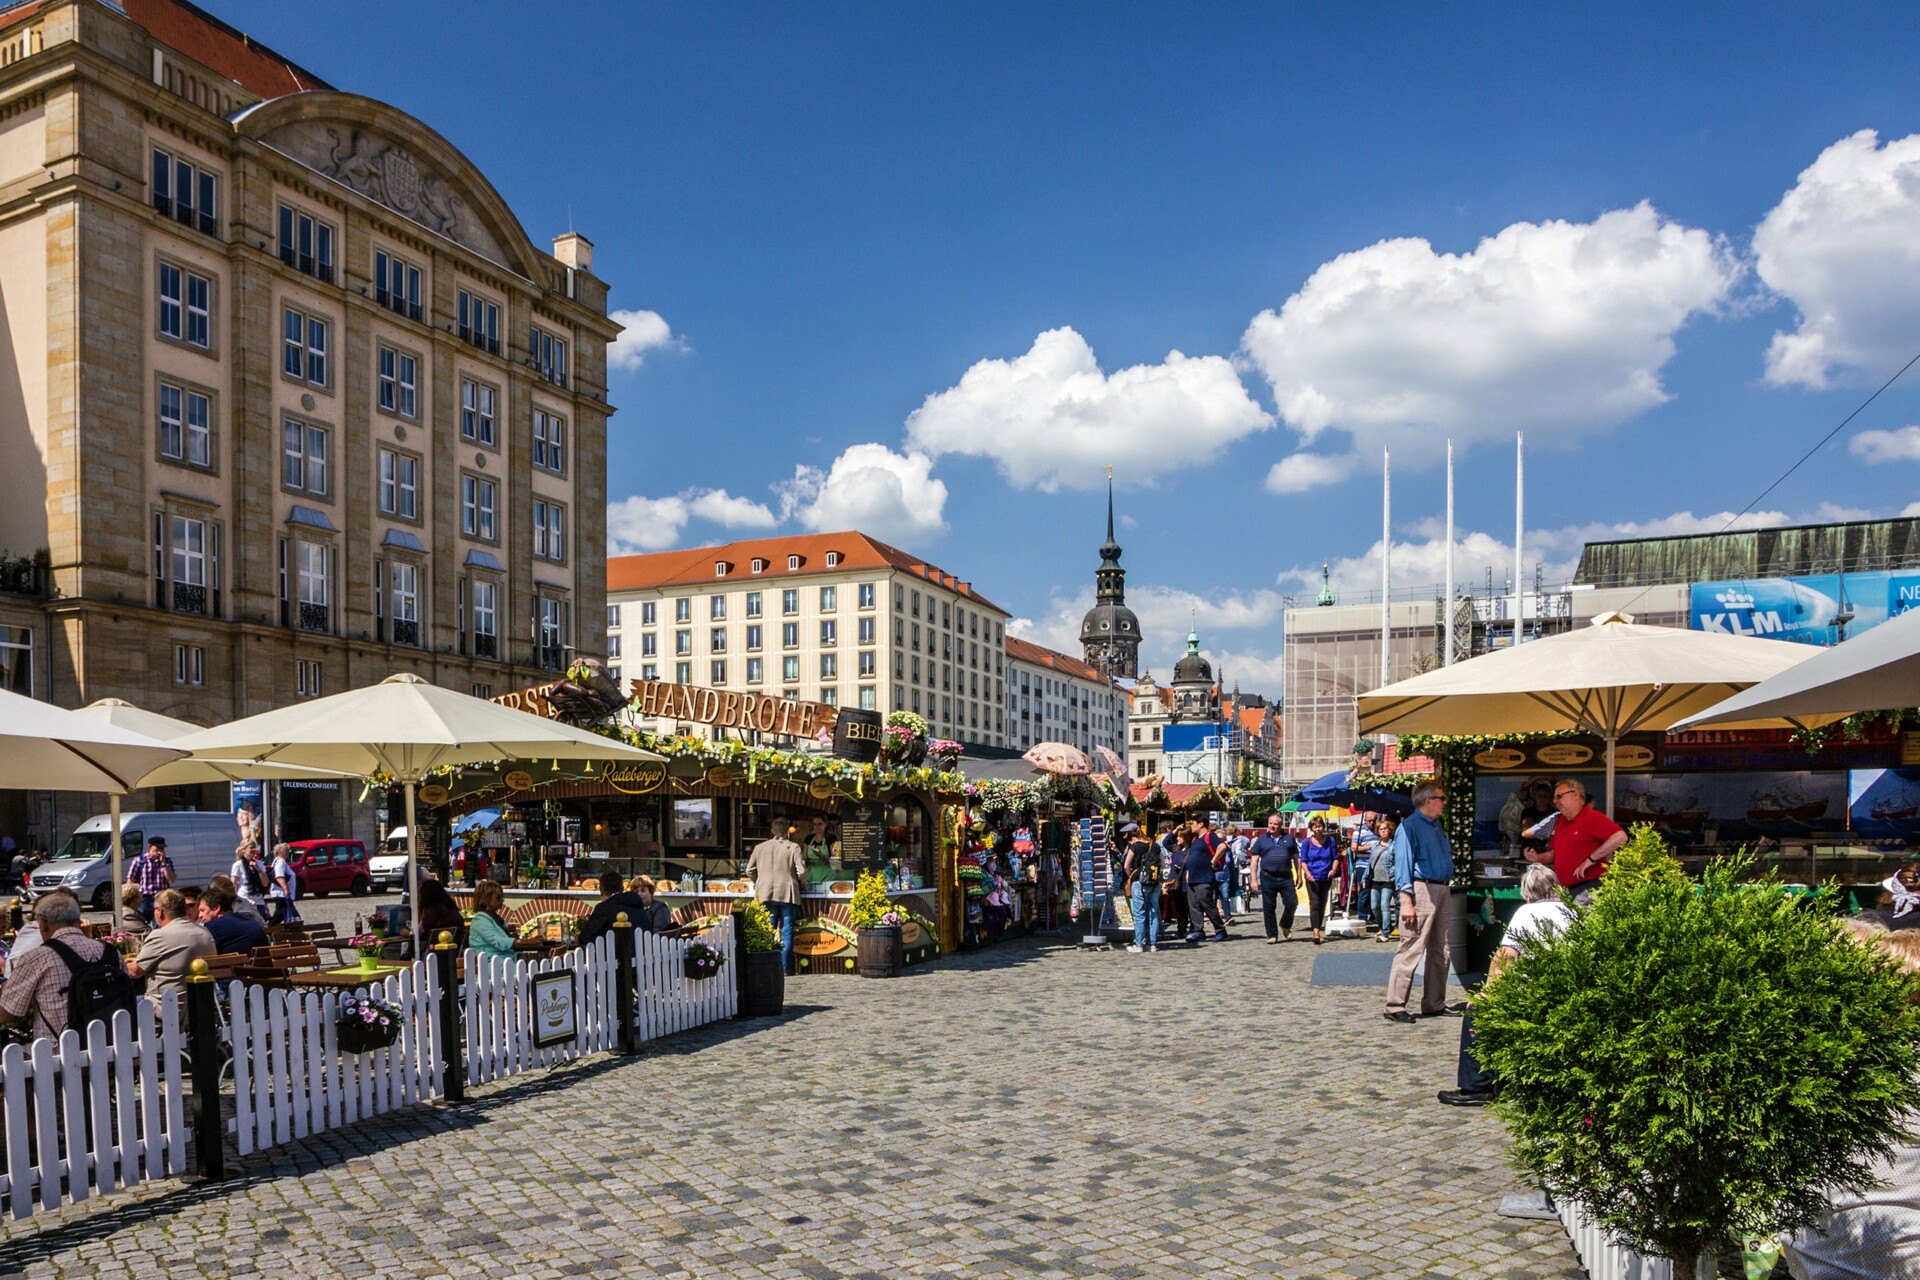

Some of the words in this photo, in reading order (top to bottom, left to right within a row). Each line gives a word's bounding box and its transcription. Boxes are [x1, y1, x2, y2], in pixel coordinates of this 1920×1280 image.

[1700, 611, 1784, 636] KLM
[639, 680, 816, 740] HANDBROTE
[846, 721, 883, 744] BIER
[600, 758, 664, 787] Radeberger
